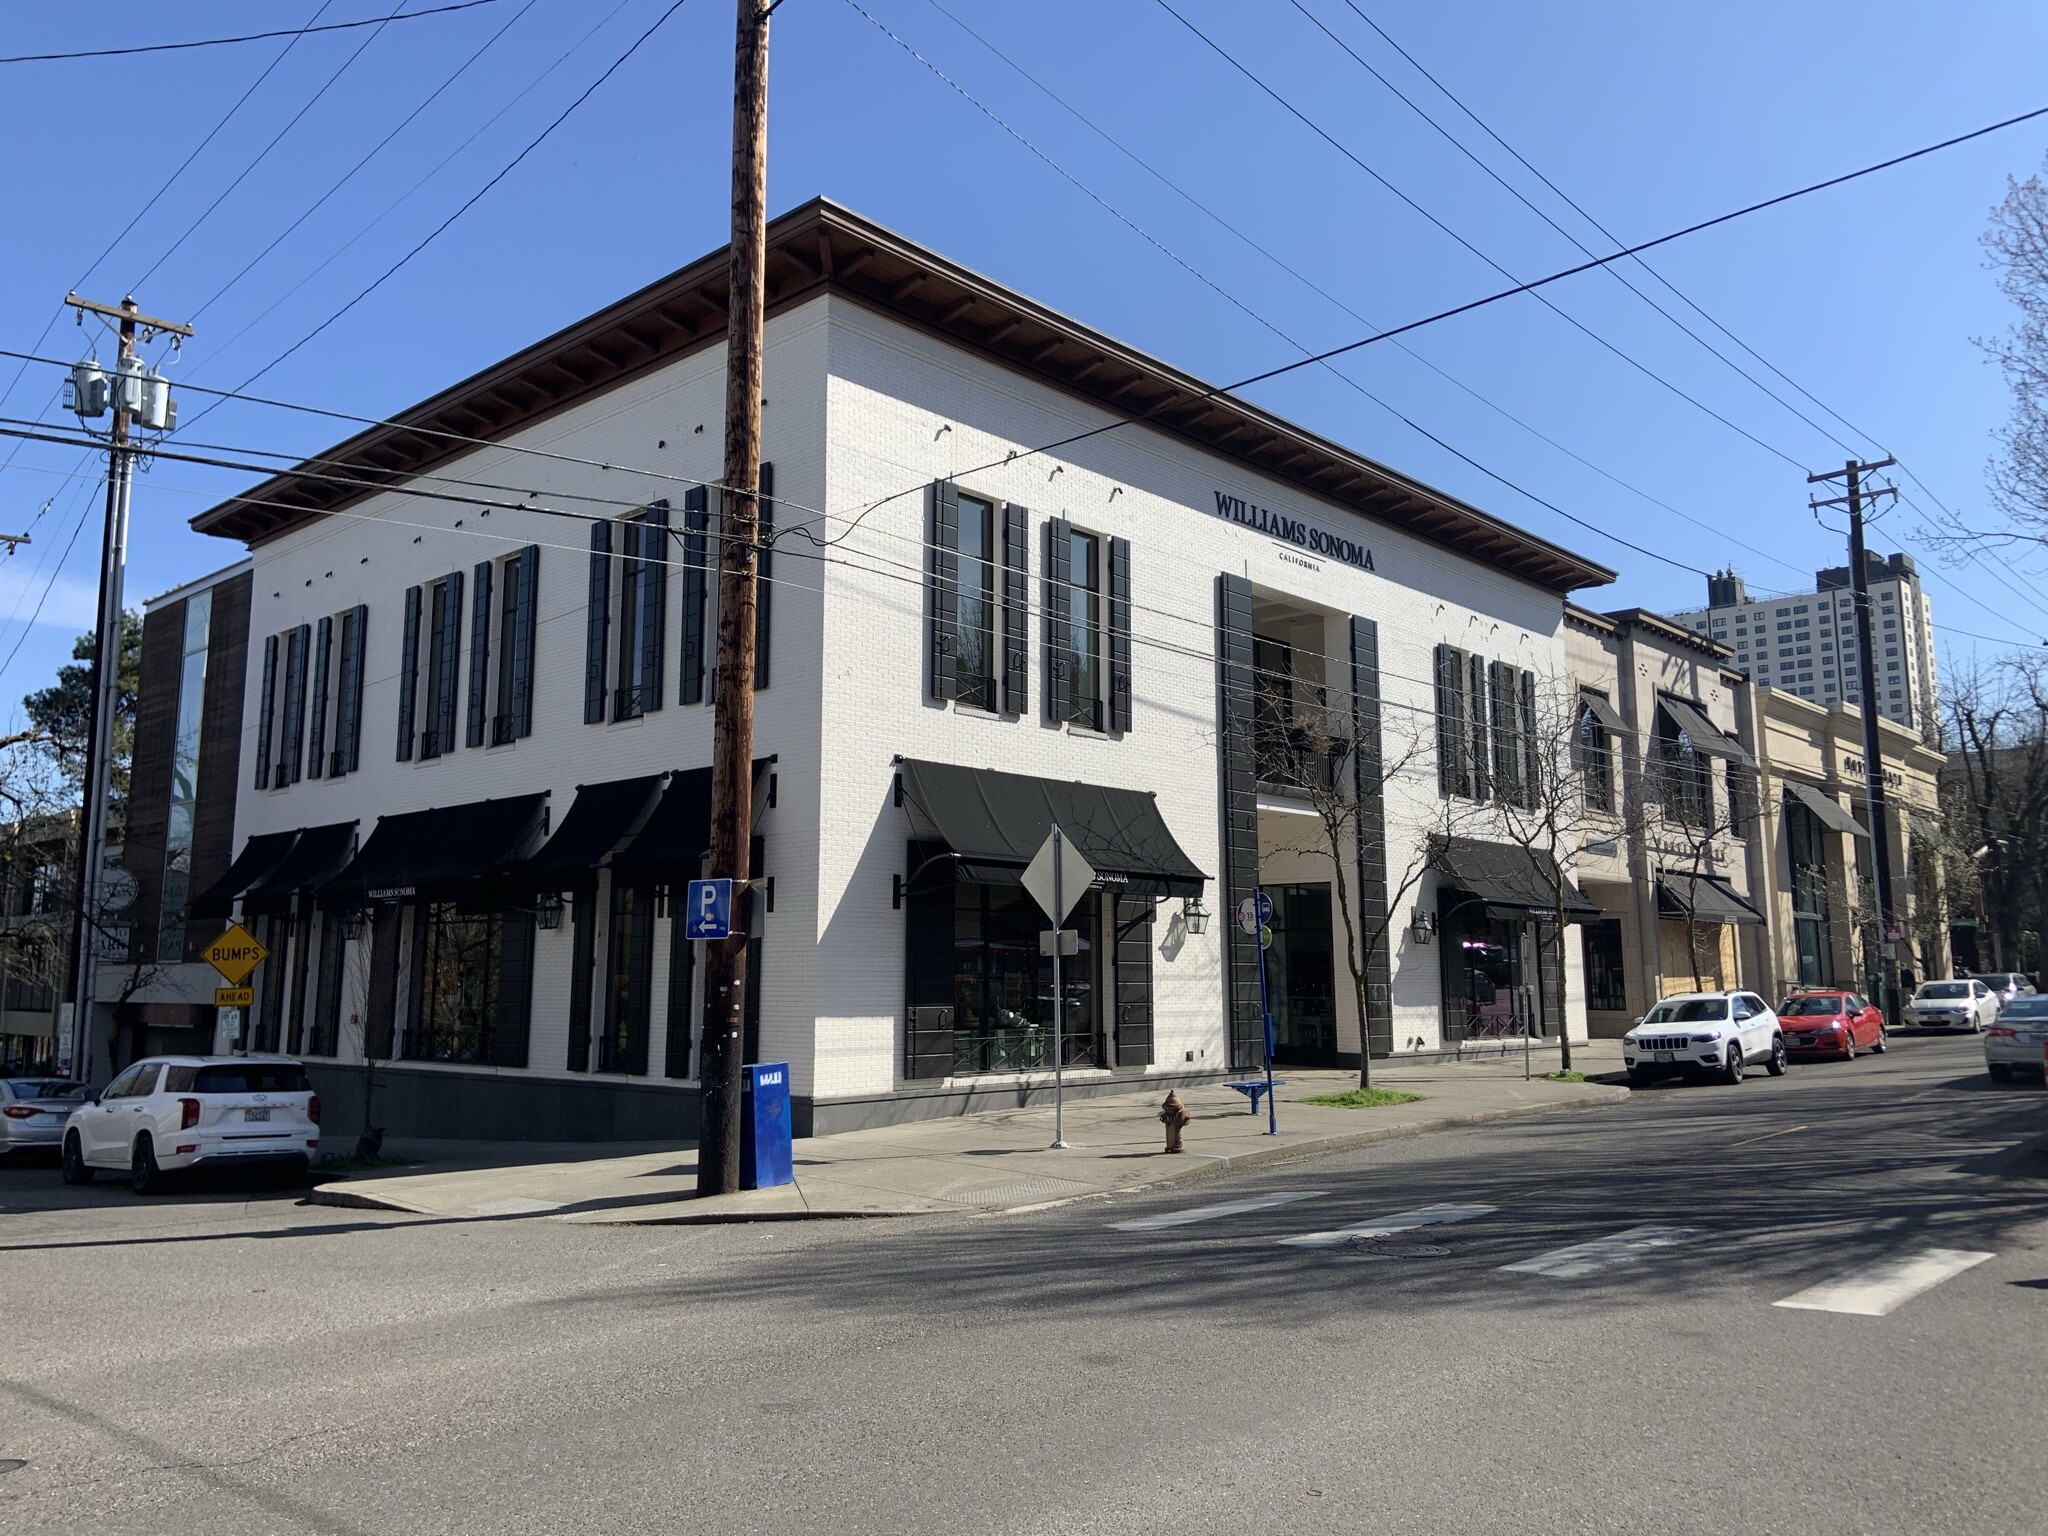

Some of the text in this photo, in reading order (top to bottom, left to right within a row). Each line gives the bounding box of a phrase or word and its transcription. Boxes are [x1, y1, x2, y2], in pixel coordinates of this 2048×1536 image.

[1214, 491, 1376, 571] WILLIAMS SONOMA
[1279, 552, 1320, 572] CALIFORNIA
[1097, 871, 1129, 883] SONOMA
[700, 885, 717, 916] P
[212, 947, 260, 961] BUMPS
[220, 992, 250, 1001] AHEAD
